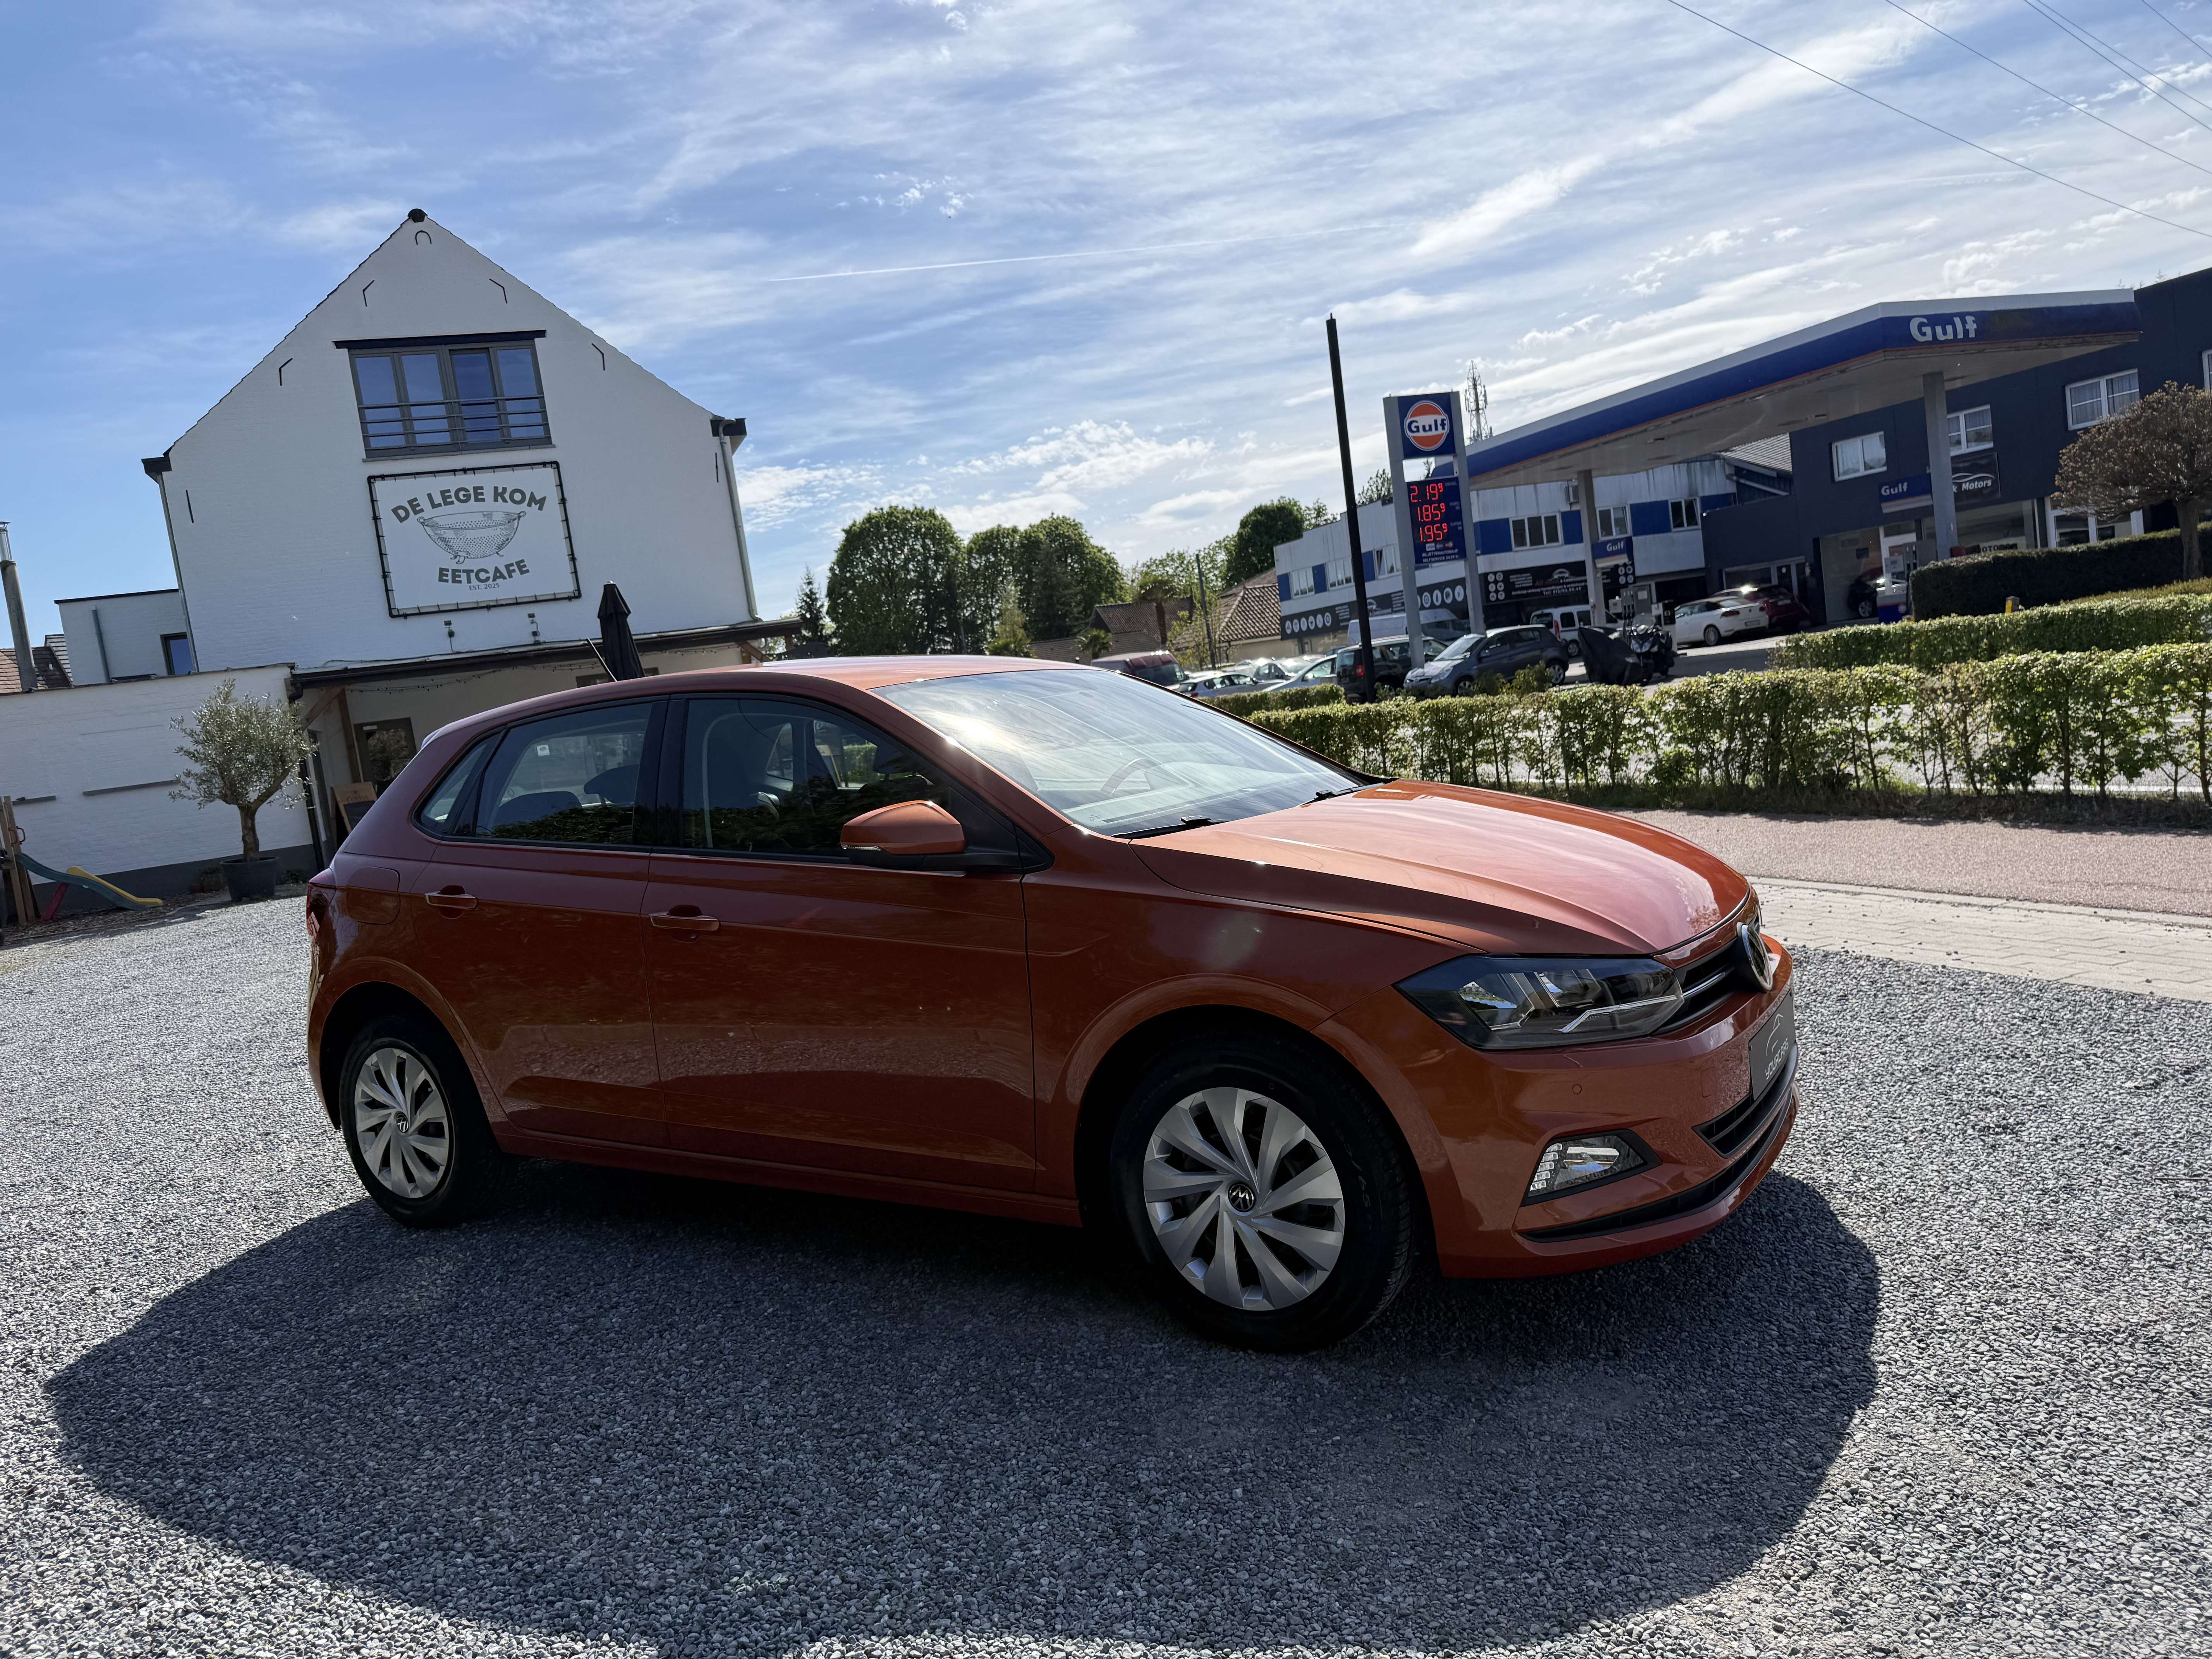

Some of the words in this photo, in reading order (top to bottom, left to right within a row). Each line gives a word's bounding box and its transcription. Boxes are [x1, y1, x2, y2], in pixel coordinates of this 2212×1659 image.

[1910, 315, 1977, 342] Gulf
[1407, 418, 1446, 433] Gulf
[1881, 482, 1908, 496] Gulf
[1962, 479, 1992, 491] Motors
[391, 497, 424, 523] DE
[427, 486, 486, 509] LEGE
[493, 486, 546, 511] KOM
[1607, 541, 1623, 551] Gulf
[438, 559, 530, 584] EETCAFE
[1765, 1037, 1789, 1080] YOURCARS
